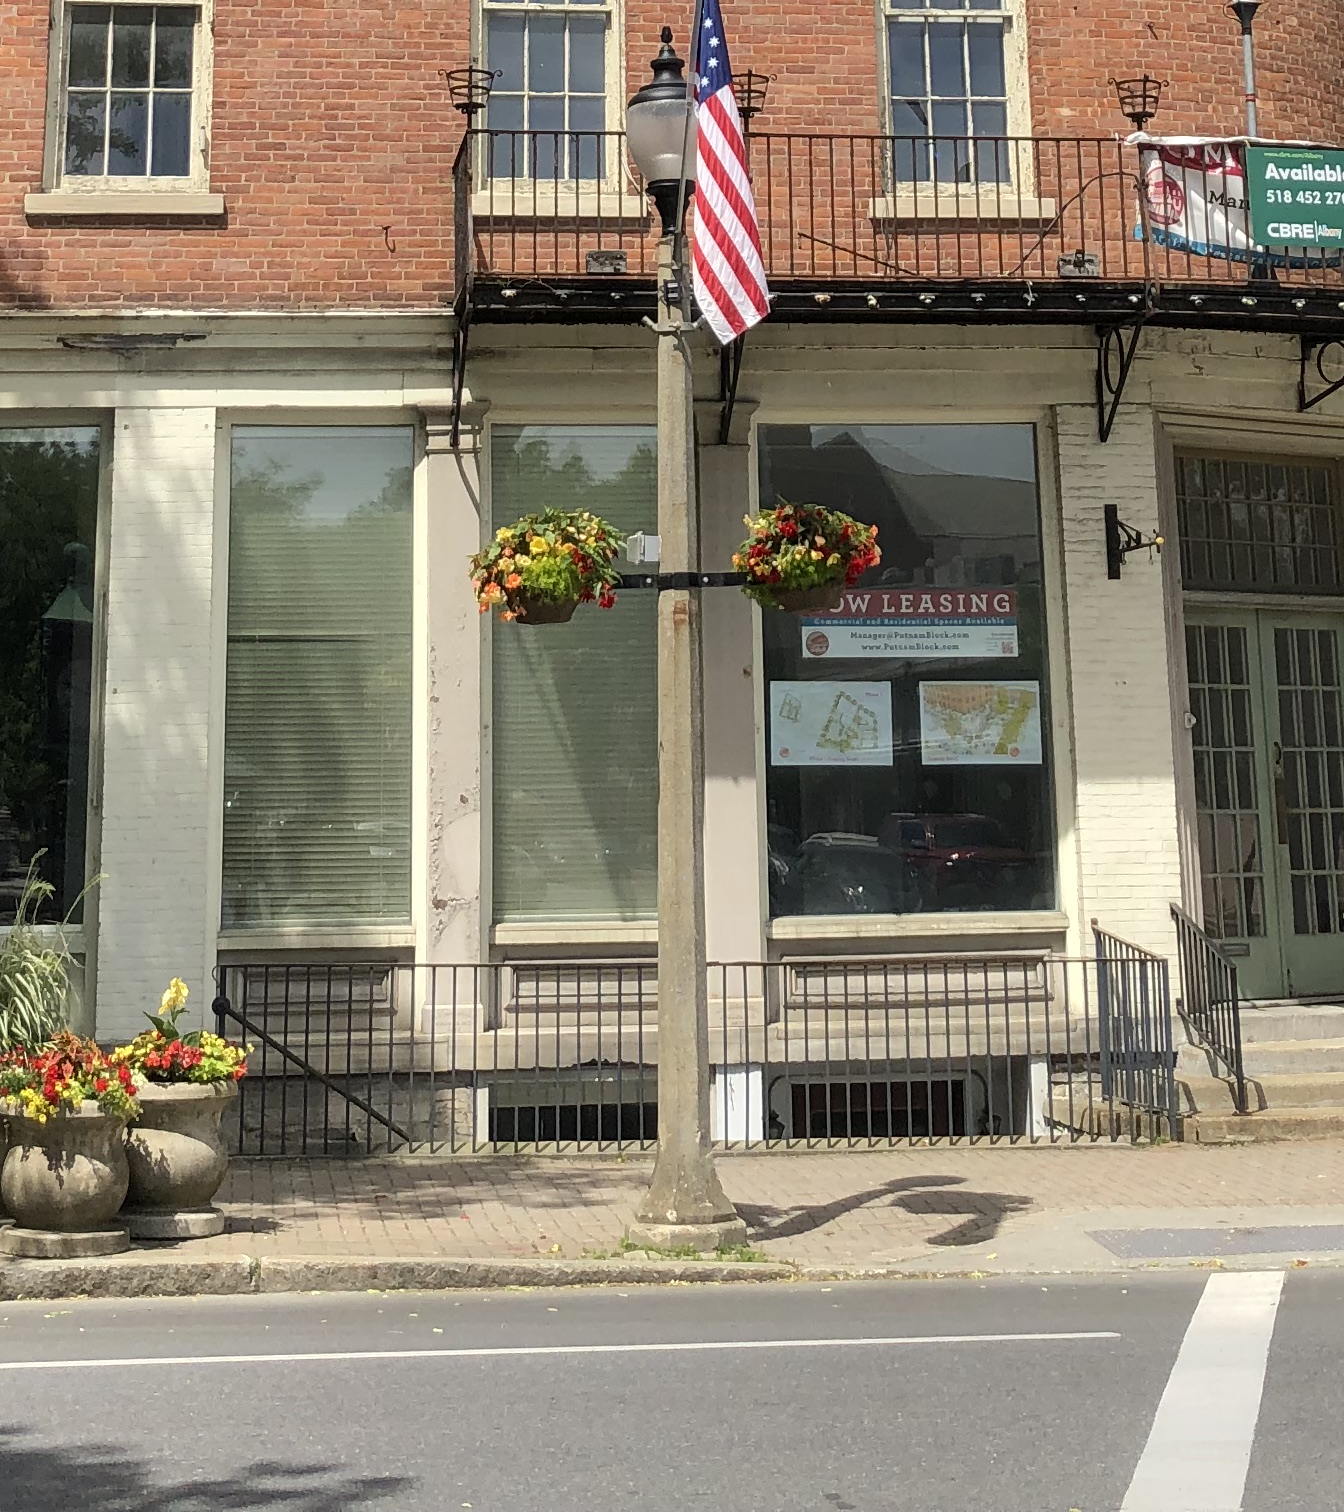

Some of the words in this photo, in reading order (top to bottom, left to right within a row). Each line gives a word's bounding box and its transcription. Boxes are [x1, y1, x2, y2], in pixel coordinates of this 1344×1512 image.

[1266, 189, 1293, 204] 518
[1295, 190, 1322, 205] 452
[1267, 222, 1315, 239] CBRE
[881, 593, 1011, 614] LEASING
[814, 617, 863, 626] Commercial
[866, 617, 881, 626] and
[883, 617, 932, 626] Residential
[934, 617, 963, 627] Spaces
[965, 616, 1006, 626] Available
